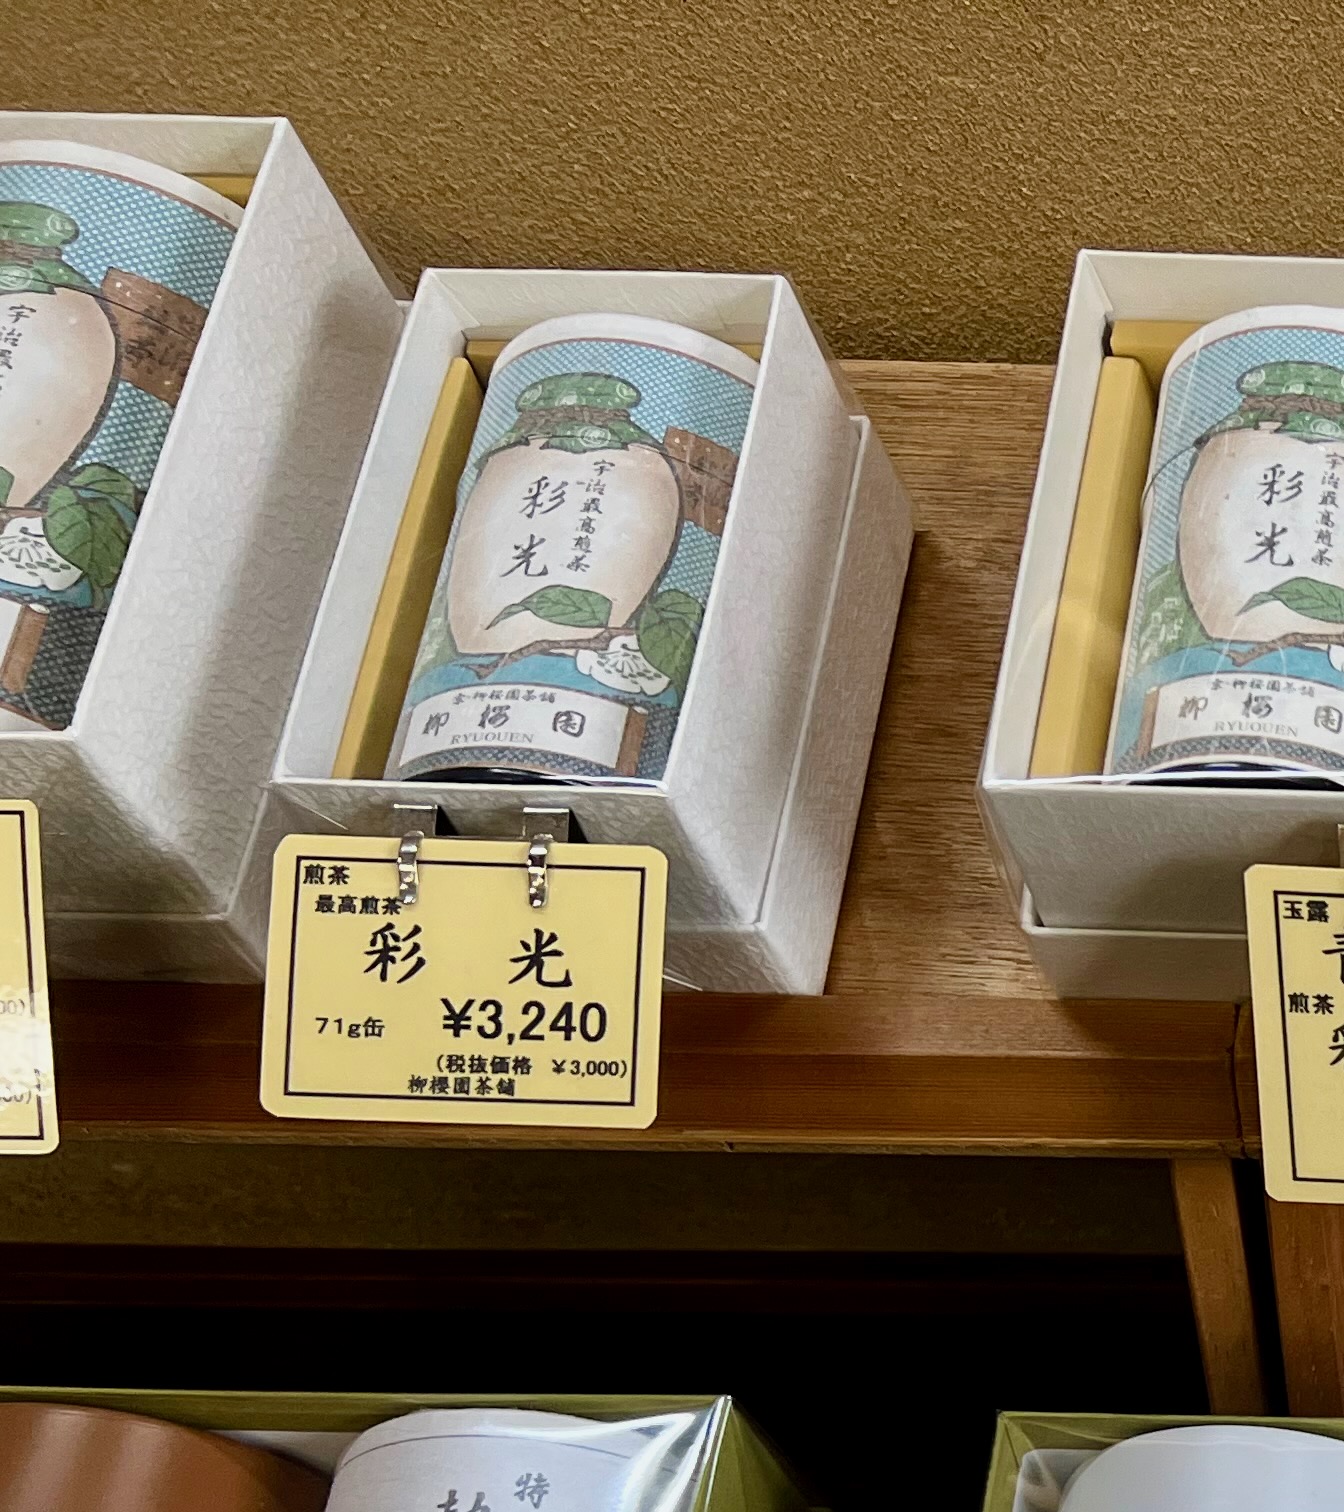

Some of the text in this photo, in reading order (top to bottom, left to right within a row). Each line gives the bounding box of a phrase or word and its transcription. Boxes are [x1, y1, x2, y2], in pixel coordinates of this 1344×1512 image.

[500, 475, 569, 578] 彩光
[1244, 463, 1305, 567] 彩光
[303, 864, 350, 886] 煎茶
[314, 894, 403, 916] 最高煎茶
[1283, 900, 1330, 923] 玉露
[363, 921, 573, 989] 彩光
[1287, 992, 1335, 1015] 煎茶
[314, 997, 608, 1045] 71g缶 ¥3,240
[436, 1053, 628, 1079] (税抜価格 ¥3,000)
